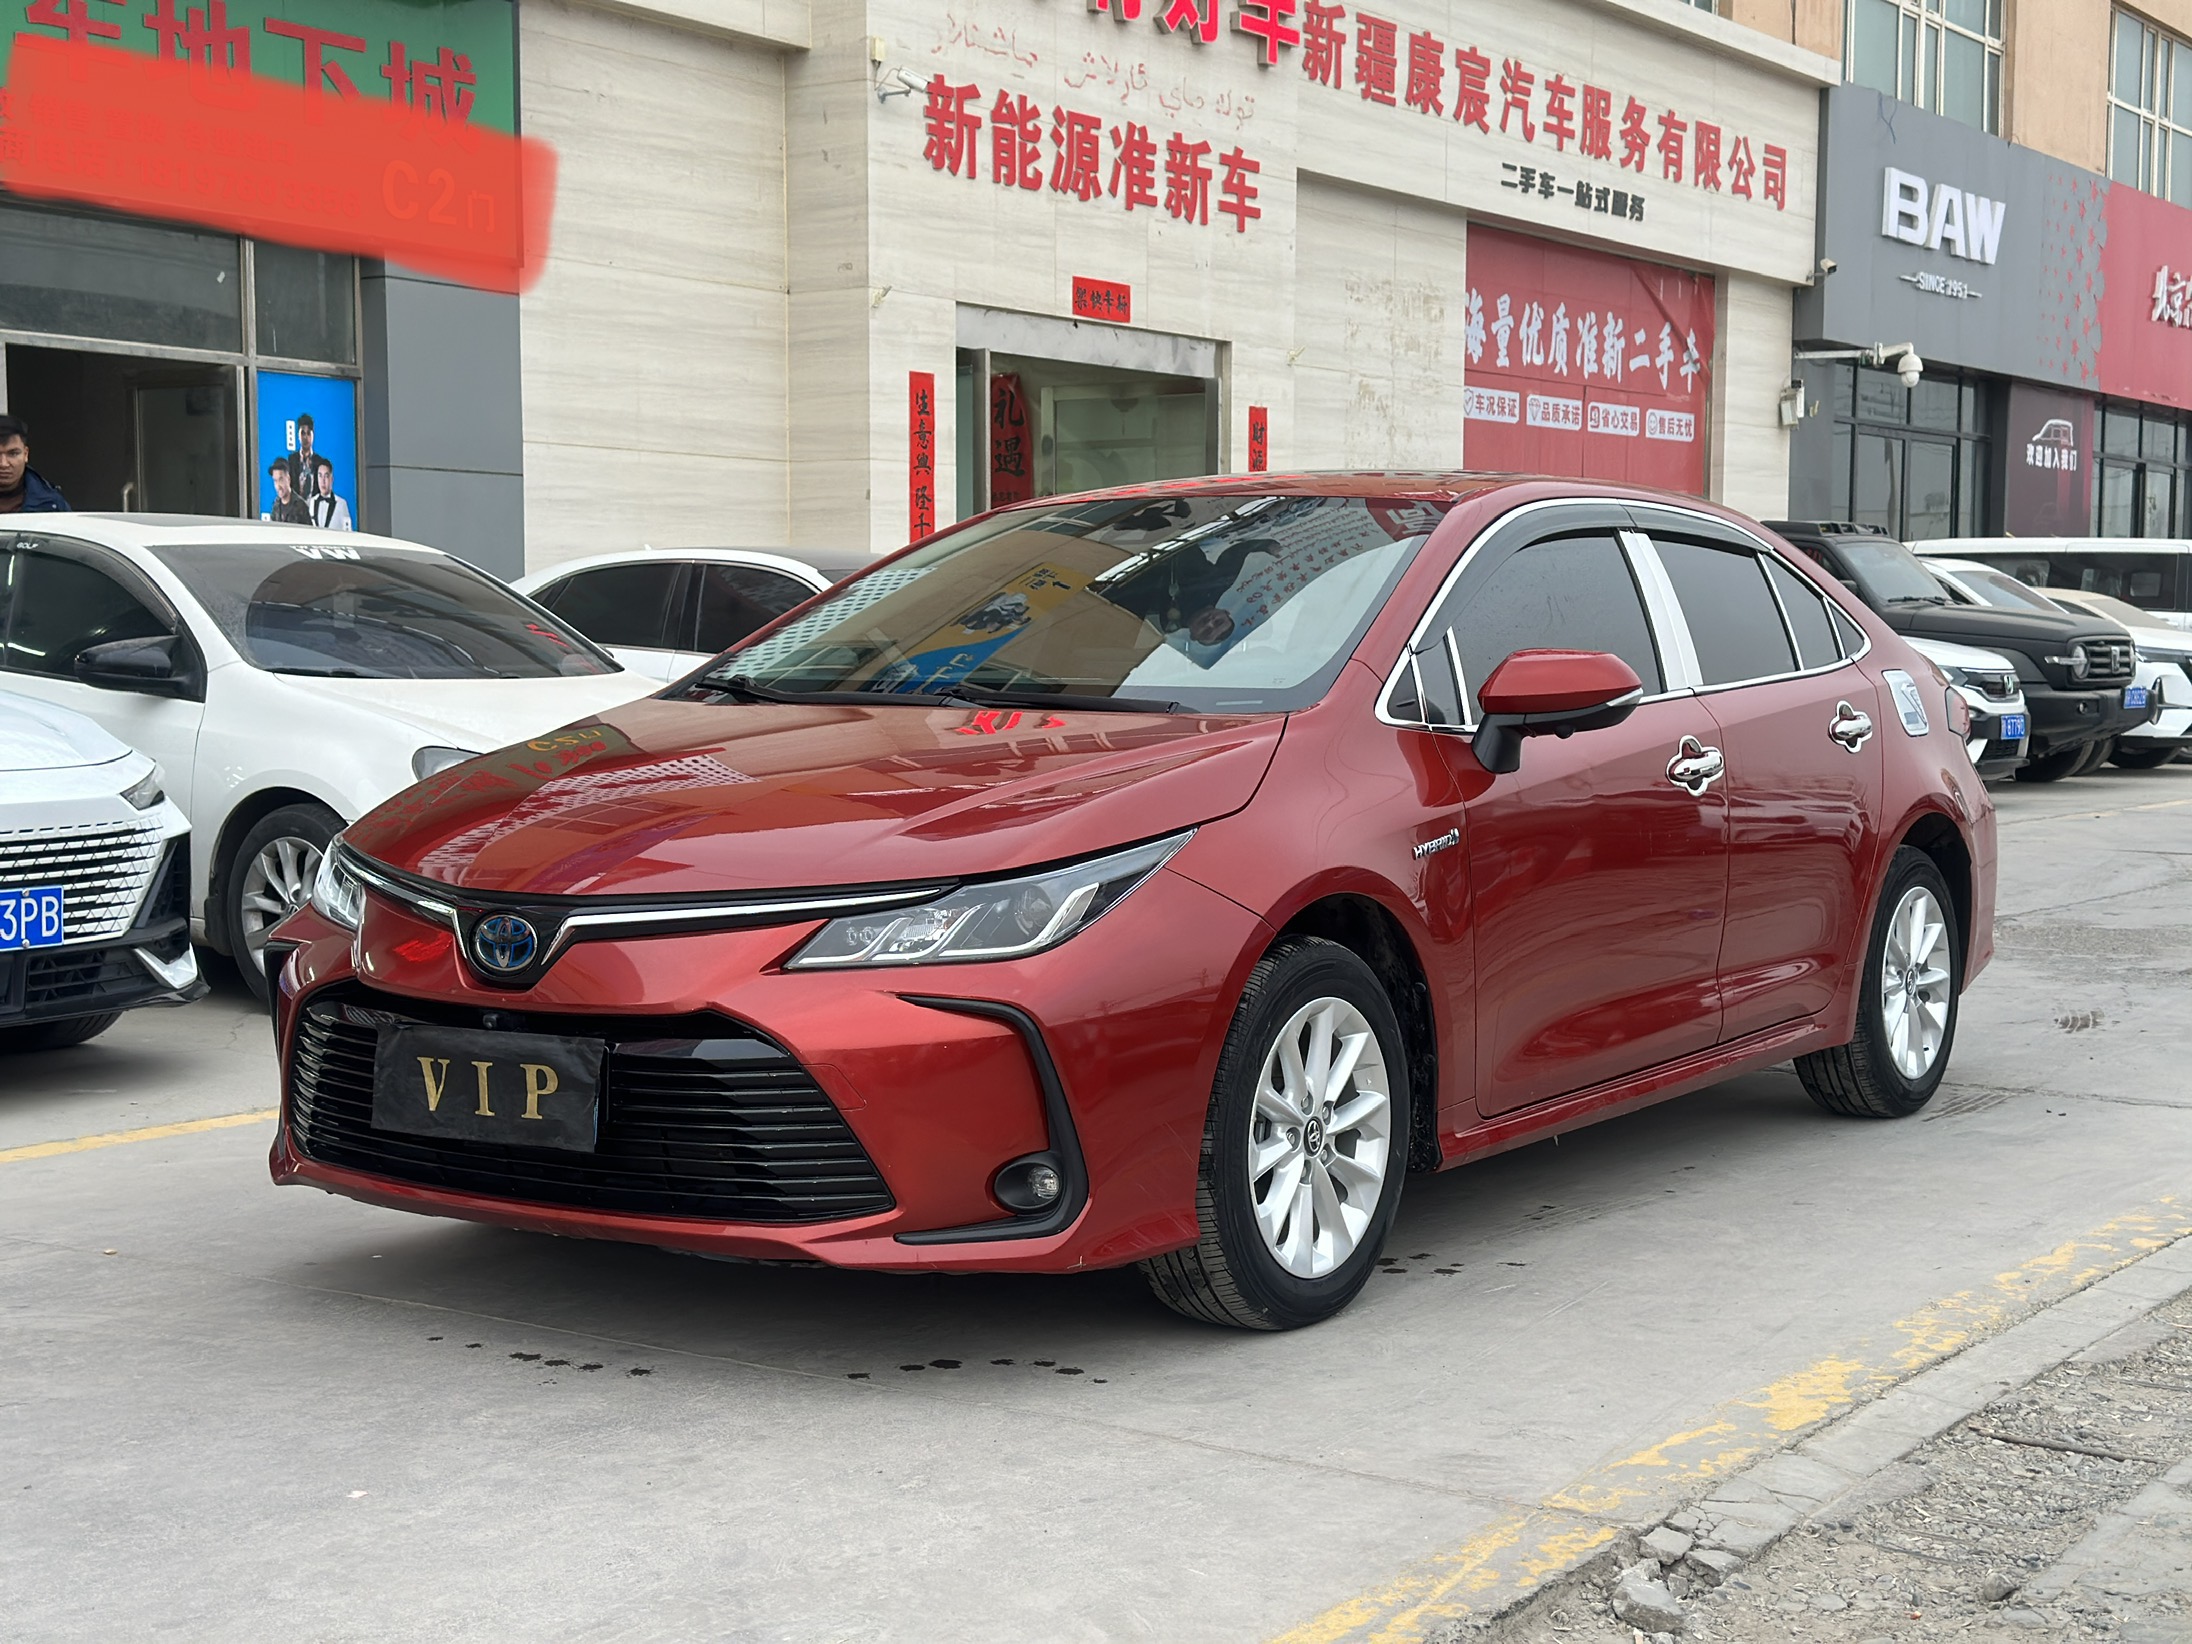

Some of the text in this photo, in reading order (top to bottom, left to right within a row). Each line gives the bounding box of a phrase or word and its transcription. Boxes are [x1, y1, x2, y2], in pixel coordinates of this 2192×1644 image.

[1302, 1, 1788, 211] 新疆康宸汽车服务有限公司
[923, 74, 1261, 233] 新能源准新车
[1500, 162, 1646, 222] 二手车一站式服务
[1882, 167, 2006, 265] BAW
[1917, 271, 1945, 295] SINCE
[1413, 833, 1453, 859] HYBRID
[417, 1056, 559, 1120] VIP
